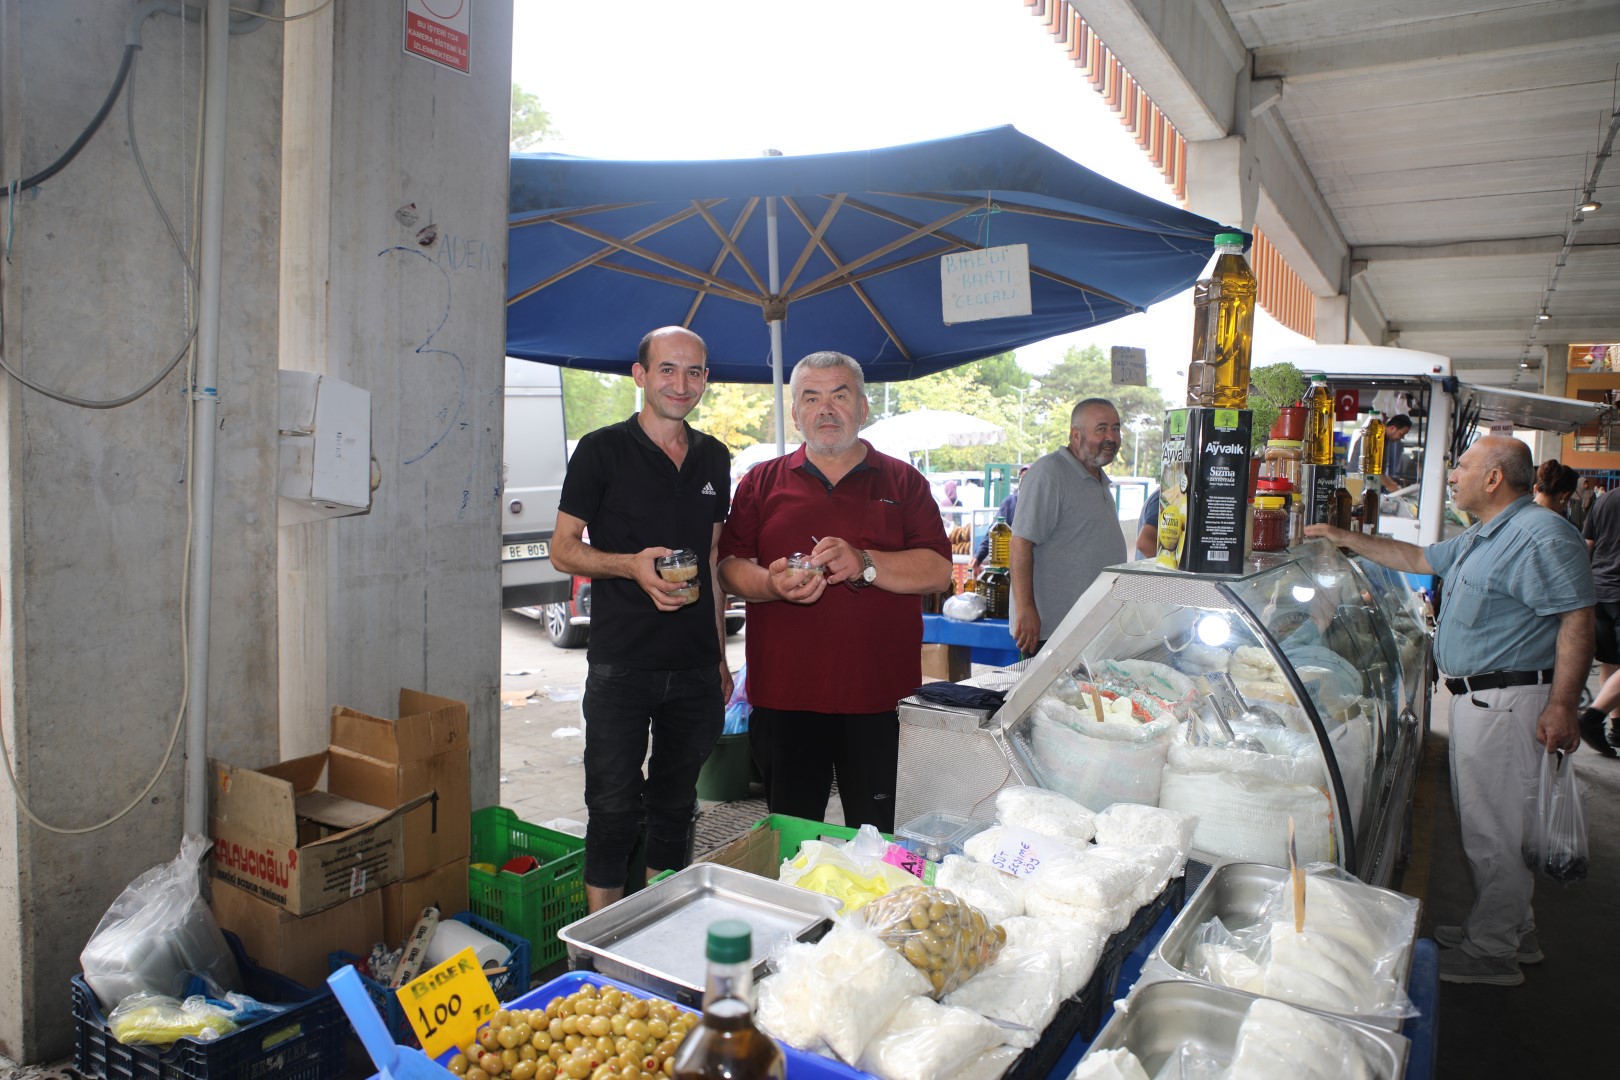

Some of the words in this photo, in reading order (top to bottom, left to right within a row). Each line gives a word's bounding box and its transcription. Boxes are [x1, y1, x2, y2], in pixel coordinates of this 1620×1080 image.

[418, 20, 426, 29] BU
[427, 23, 446, 37] İŞYERİ
[448, 32, 458, 42] 7/24
[408, 28, 434, 42] KAMERA
[434, 38, 457, 53] SİSTEMİ
[458, 48, 467, 56] İLE
[1205, 442, 1244, 456] Ayvalık
[1210, 466, 1235, 477] Sızma
[510, 546, 521, 558] BE
[528, 544, 545, 556] 809
[419, 994, 462, 1039] 100
